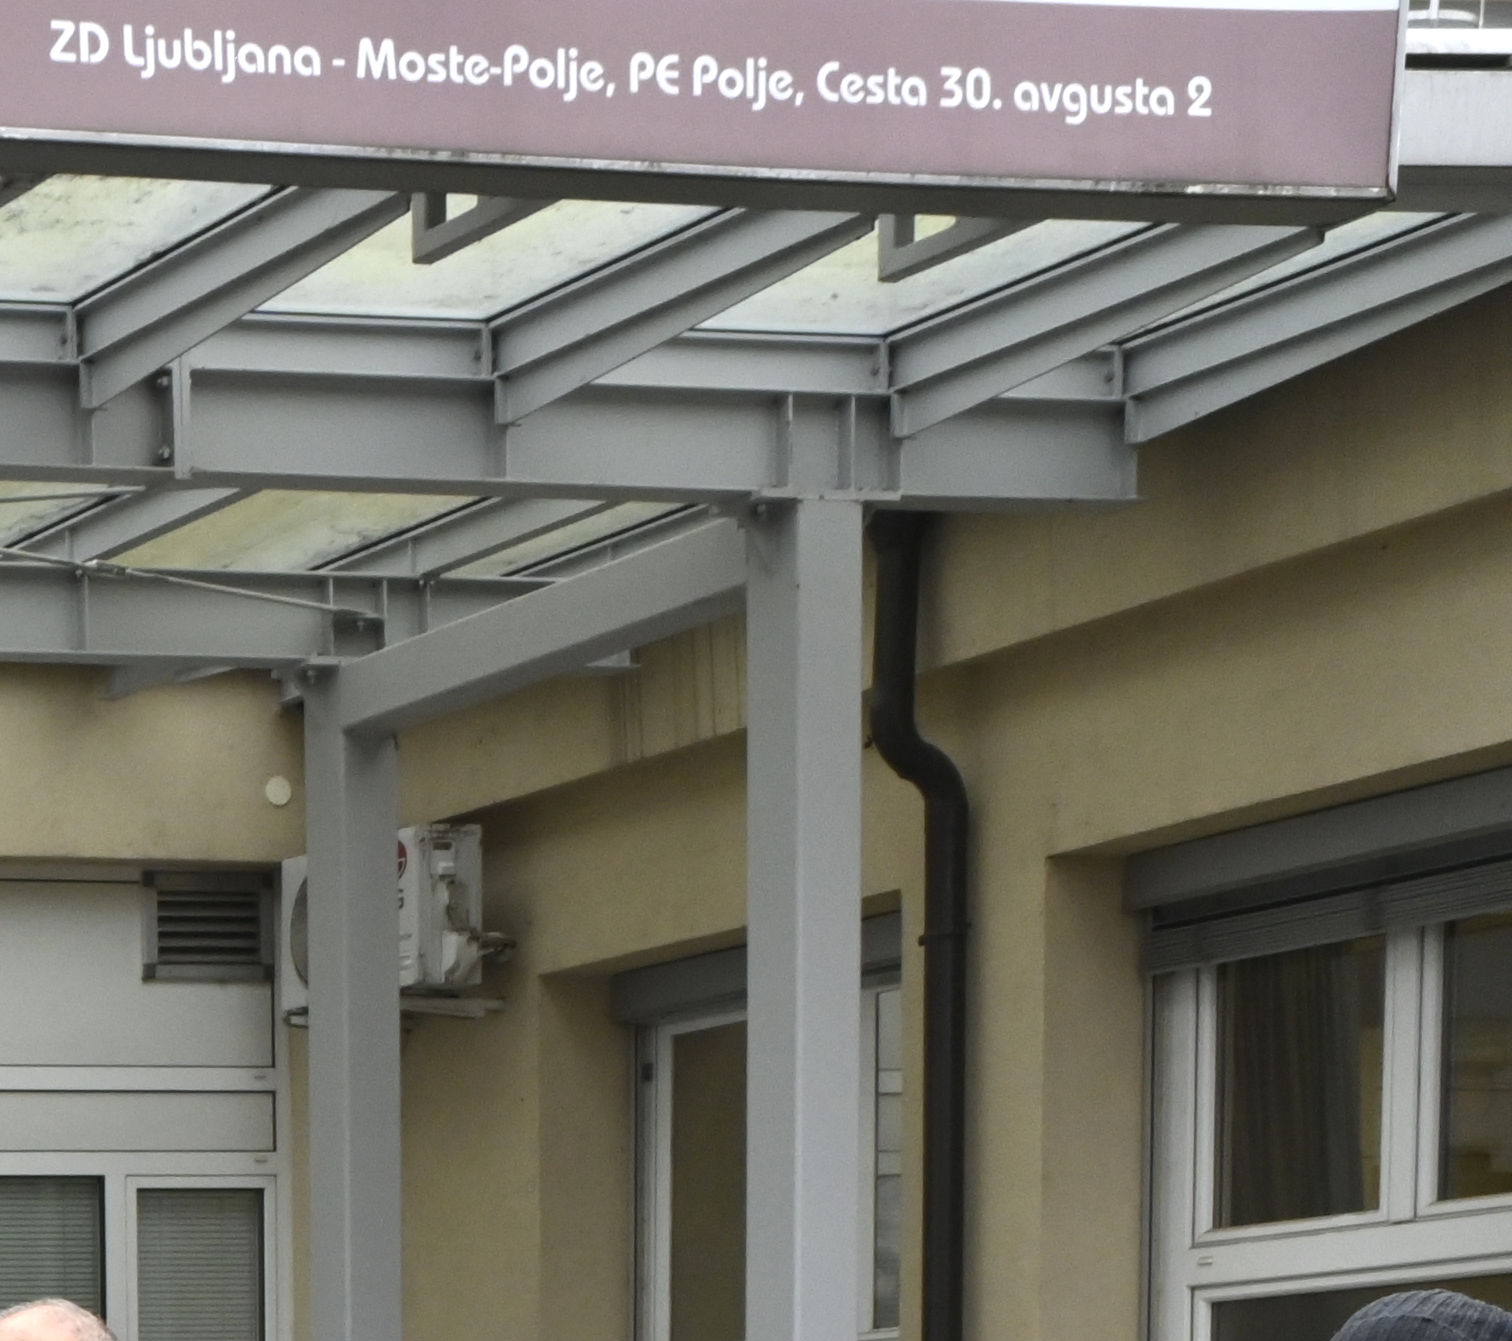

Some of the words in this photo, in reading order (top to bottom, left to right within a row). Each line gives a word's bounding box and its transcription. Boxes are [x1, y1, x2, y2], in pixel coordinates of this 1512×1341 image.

[48, 19, 110, 64] ZD
[124, 25, 322, 81] Ljubljana
[357, 38, 616, 101] Moste-Polje,
[629, 53, 680, 97] PE
[692, 56, 805, 109] Polje,
[817, 61, 928, 107] Cesta
[940, 67, 1003, 112] 30.
[1013, 72, 1175, 125] avgusta
[1187, 76, 1212, 119] 2
